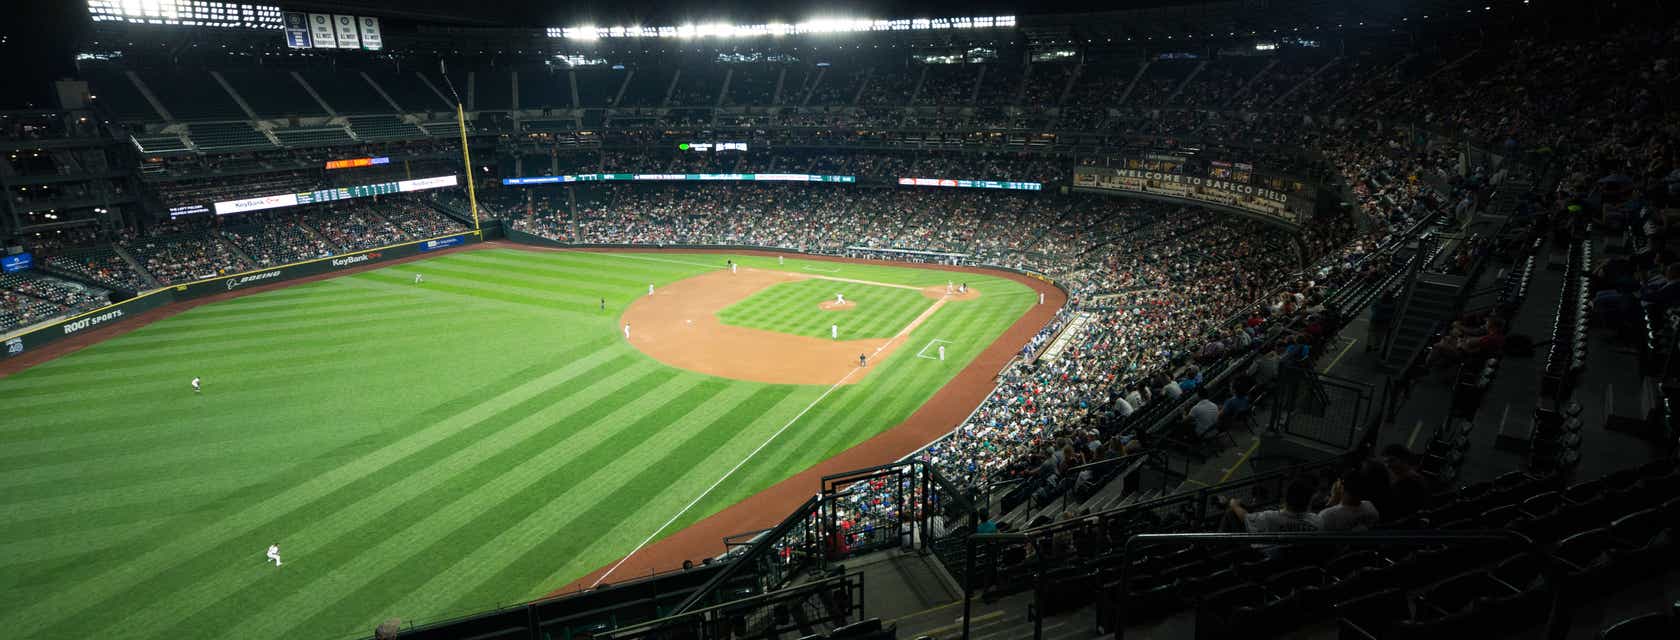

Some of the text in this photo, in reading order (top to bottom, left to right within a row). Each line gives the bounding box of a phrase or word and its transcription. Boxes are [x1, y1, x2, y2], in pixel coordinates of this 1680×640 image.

[1116, 169, 1287, 202] WELCOME TO SAFECO FIELD
[332, 254, 368, 266] KeyBank
[240, 271, 281, 283] BOEING
[64, 318, 91, 334] ROOT
